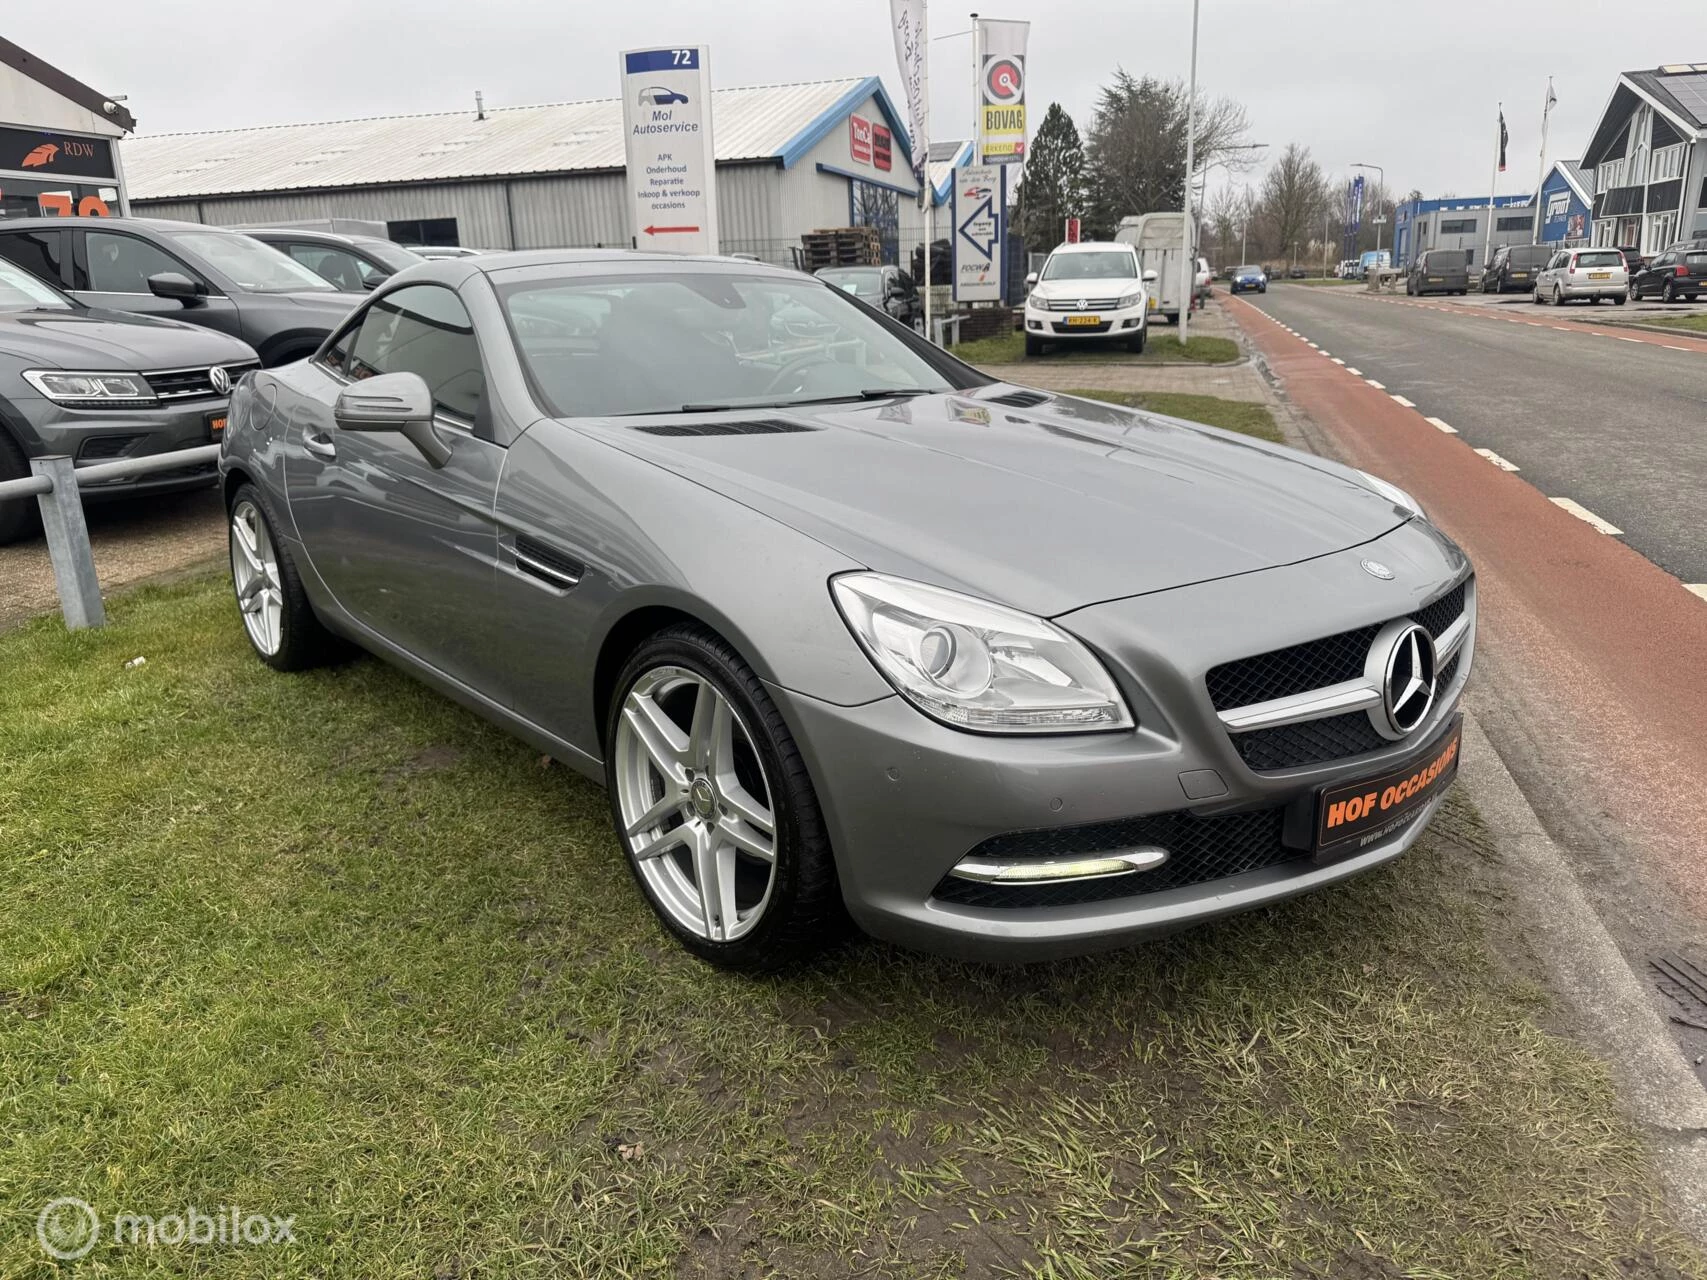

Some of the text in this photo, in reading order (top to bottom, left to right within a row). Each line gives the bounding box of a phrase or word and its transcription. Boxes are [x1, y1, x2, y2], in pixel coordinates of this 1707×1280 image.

[671, 49, 692, 65] 72
[652, 110, 673, 122] Mol
[986, 110, 1023, 130] BOVAG
[633, 121, 699, 136] Autoservice
[63, 141, 95, 157] RDW
[657, 153, 673, 162] APK
[646, 165, 687, 175] Onderhoud
[650, 177, 684, 186] Reparatie
[637, 189, 701, 199] Inkoop & verkoop
[651, 201, 686, 210] occasions
[1327, 792, 1378, 829] HOF
[1380, 737, 1457, 810] OCCASIONS
